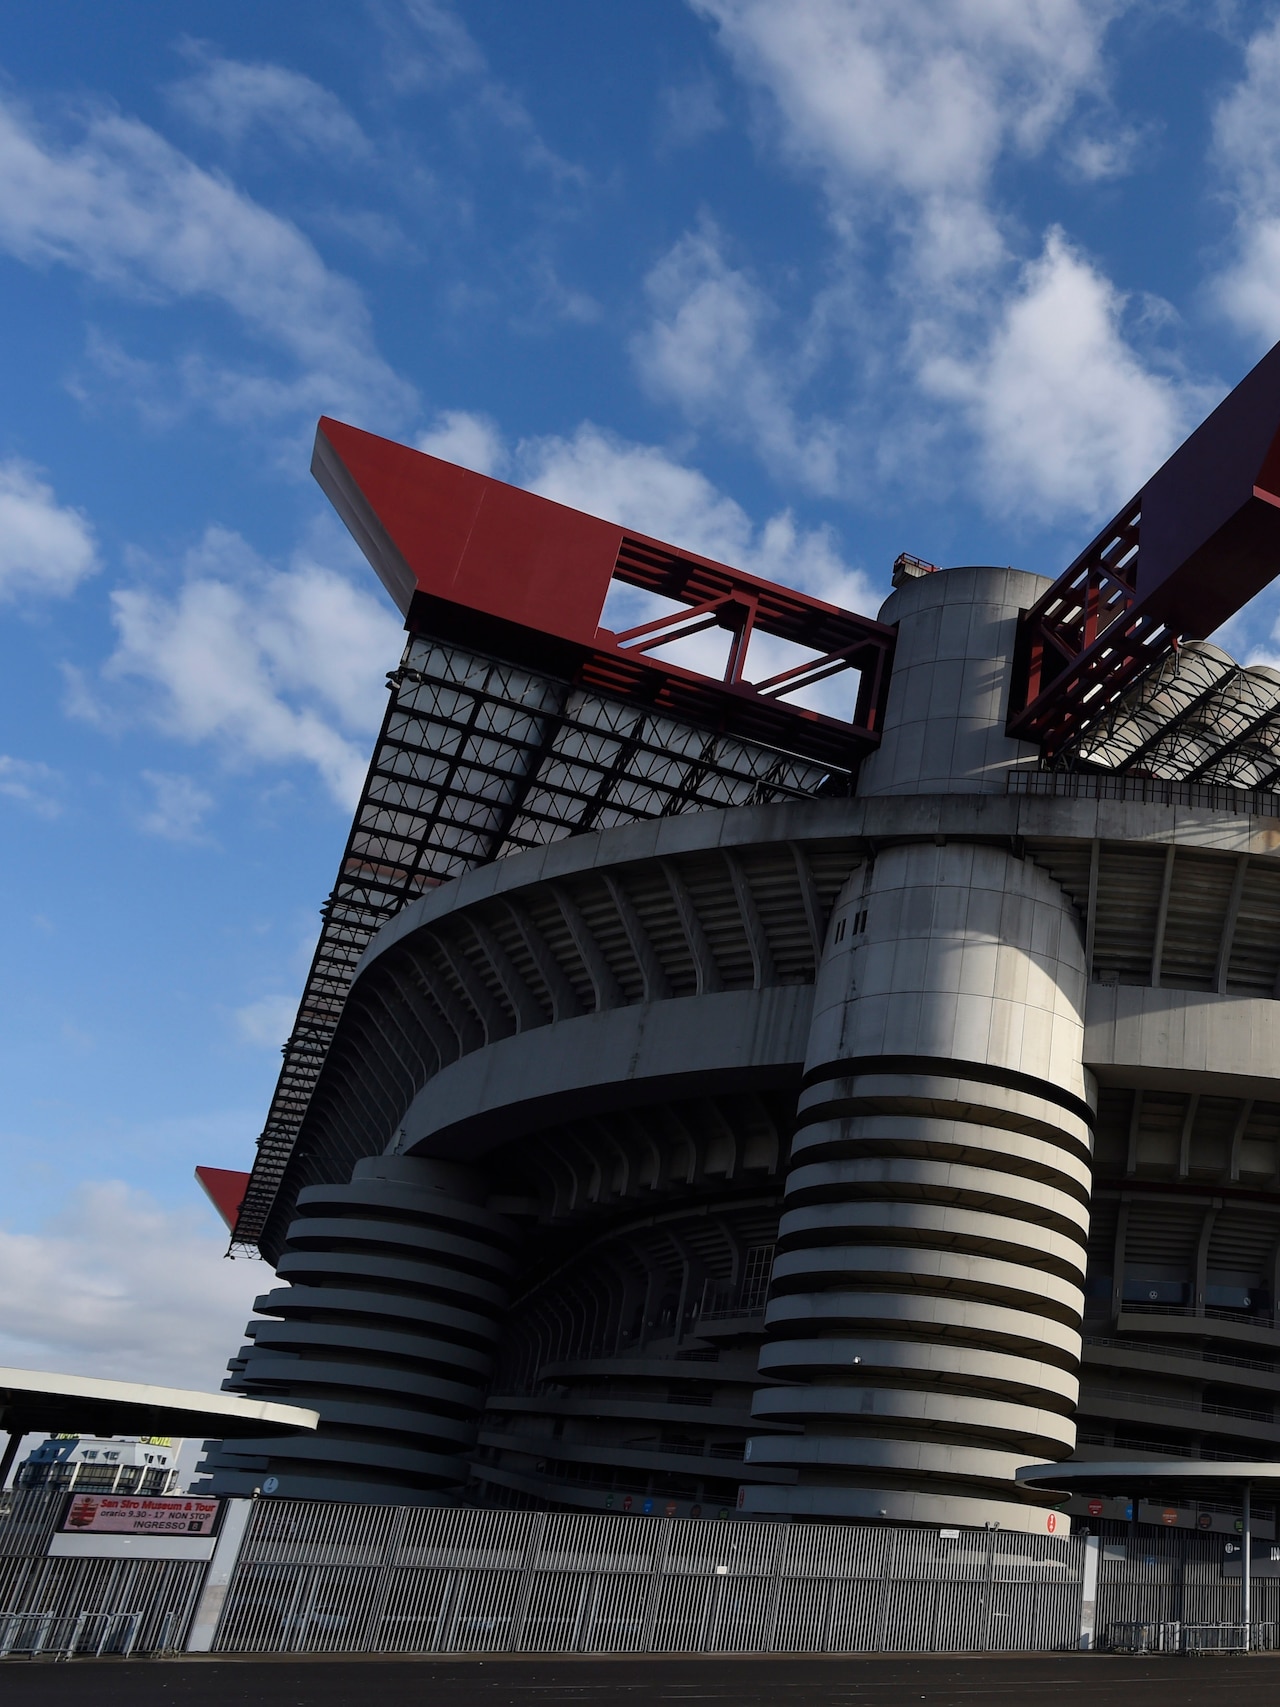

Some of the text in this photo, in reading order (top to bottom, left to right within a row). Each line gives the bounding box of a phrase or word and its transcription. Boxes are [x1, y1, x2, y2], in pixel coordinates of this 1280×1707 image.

[100, 1499, 216, 1512] San Siro Museum & Tour
[154, 1511, 165, 1519] 17
[133, 1520, 186, 1530] INGRESSO
